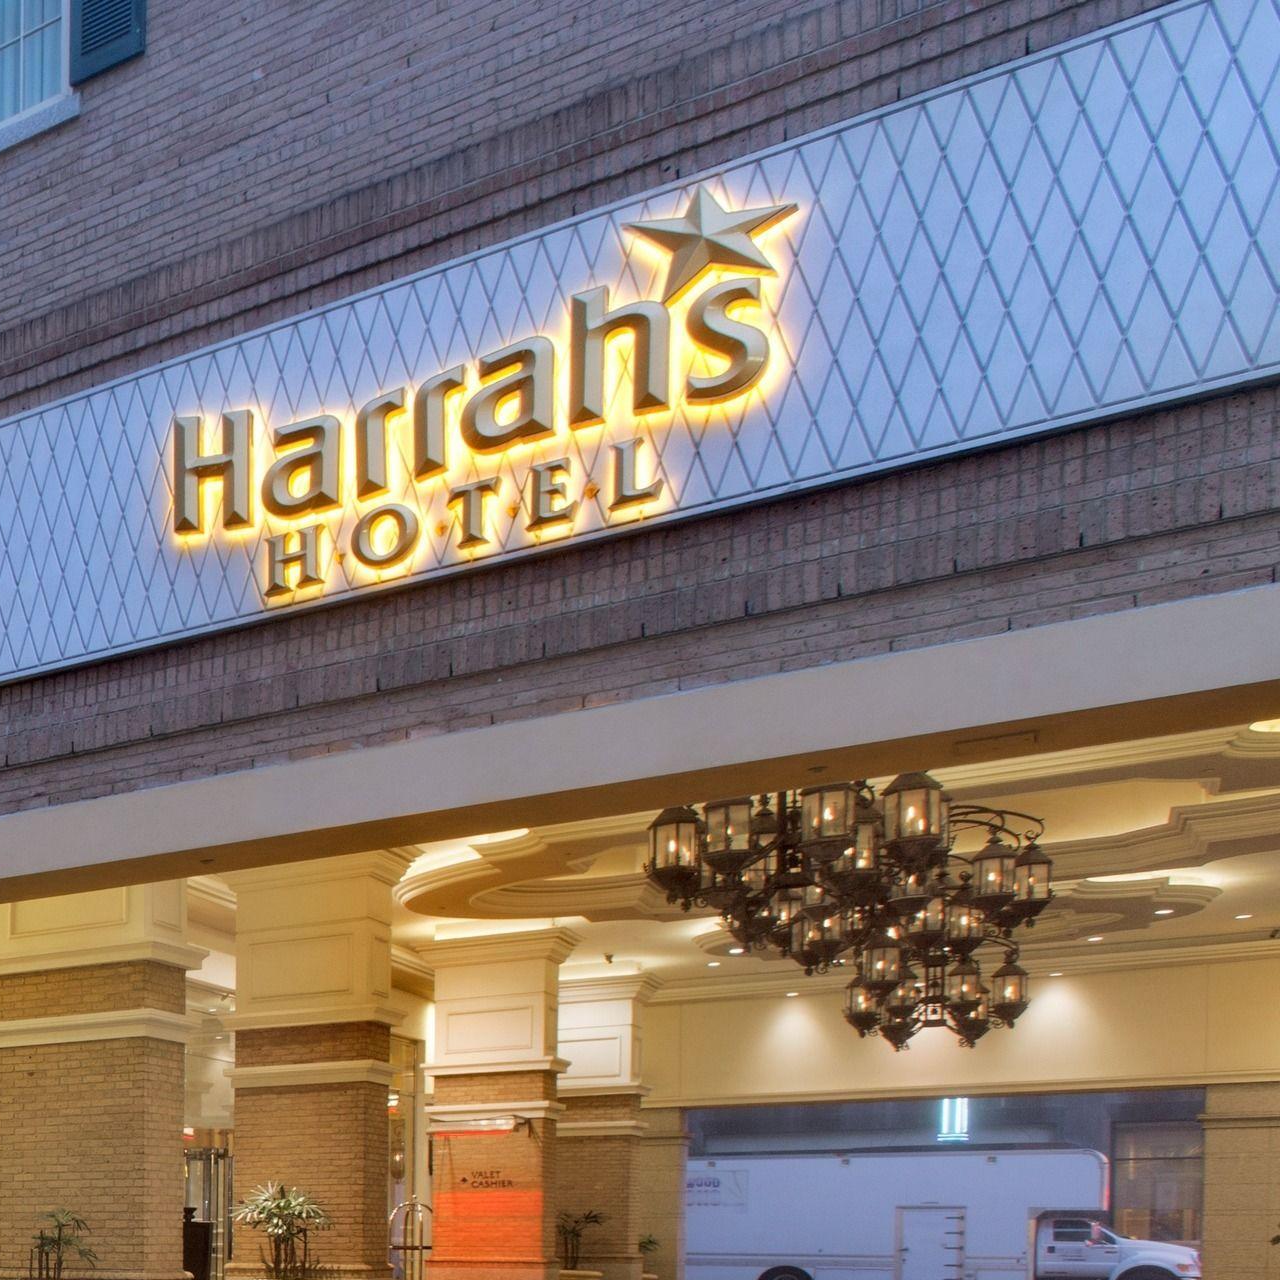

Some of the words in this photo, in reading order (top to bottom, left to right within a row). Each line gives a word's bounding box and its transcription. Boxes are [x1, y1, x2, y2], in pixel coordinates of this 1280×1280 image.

[264, 437, 664, 599] HOTEL
[470, 1170, 502, 1179] VALET
[470, 1179, 514, 1189] CASHIER
